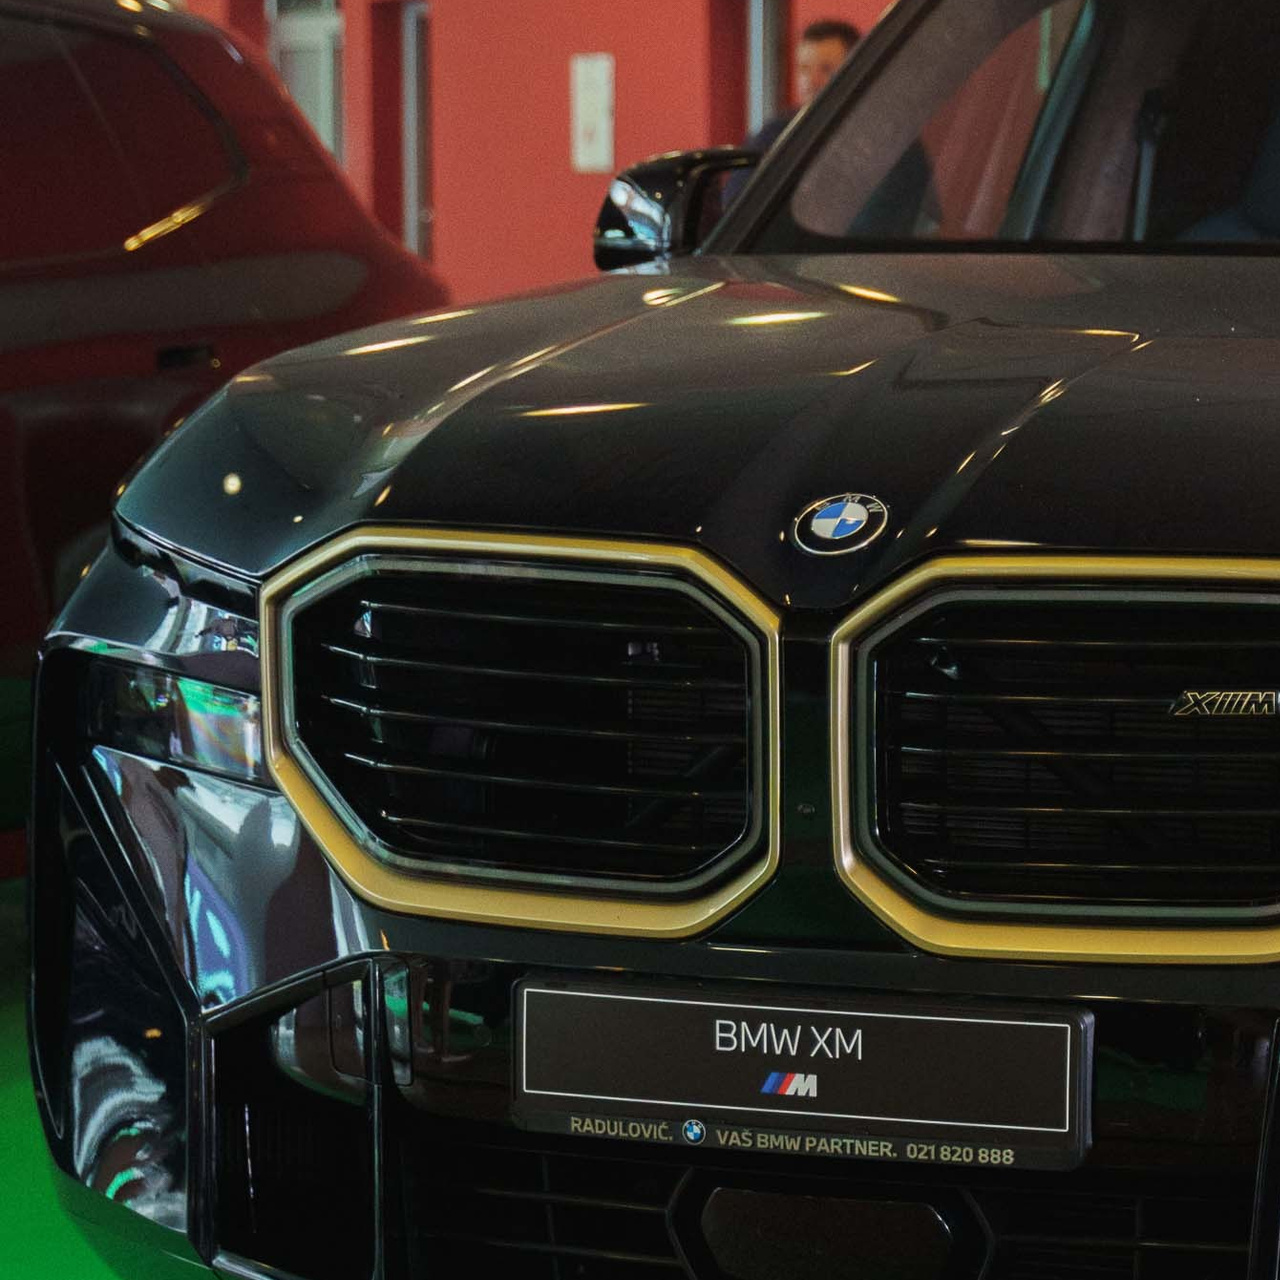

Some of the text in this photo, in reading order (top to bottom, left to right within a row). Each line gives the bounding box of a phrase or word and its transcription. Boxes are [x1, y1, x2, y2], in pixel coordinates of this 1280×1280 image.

[715, 1019, 862, 1061] BMW XM
[716, 1129, 753, 1148] VAŠ
[756, 1132, 803, 1152] BMW
[805, 1136, 898, 1158] PARTNER.
[906, 1142, 936, 1160] 021
[939, 1145, 974, 1163] 820
[977, 1147, 1015, 1165] 888
